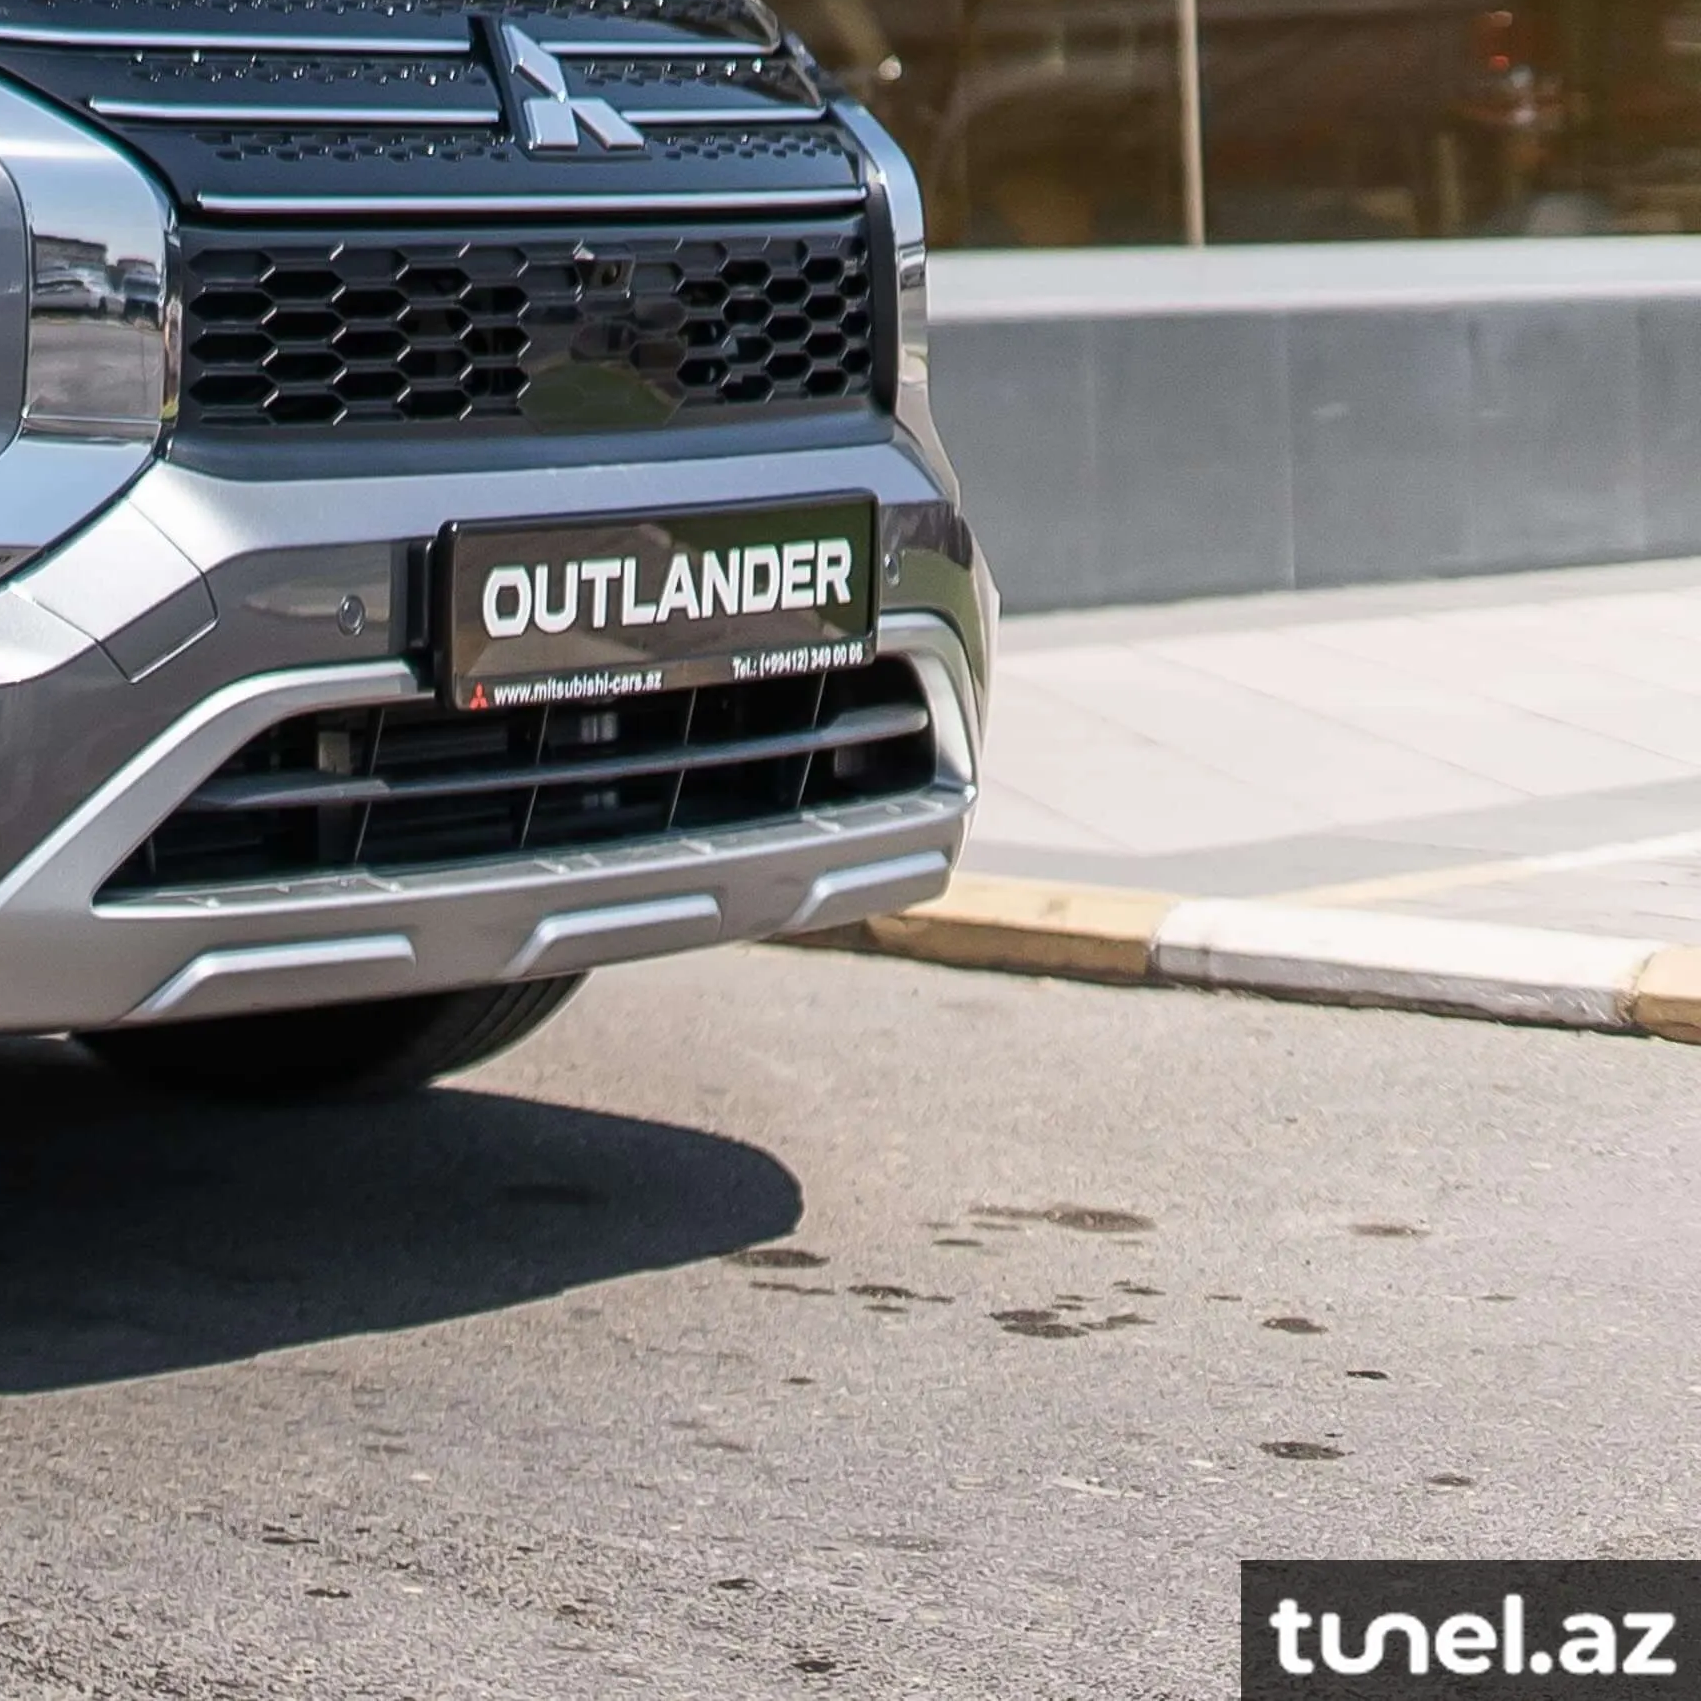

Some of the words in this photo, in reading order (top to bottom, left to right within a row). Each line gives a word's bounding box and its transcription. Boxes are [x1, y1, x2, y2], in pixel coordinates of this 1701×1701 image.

[482, 537, 853, 638] OUTLANDER
[833, 644, 847, 667] 00
[494, 670, 663, 706] www.mitsubishi-cars.az
